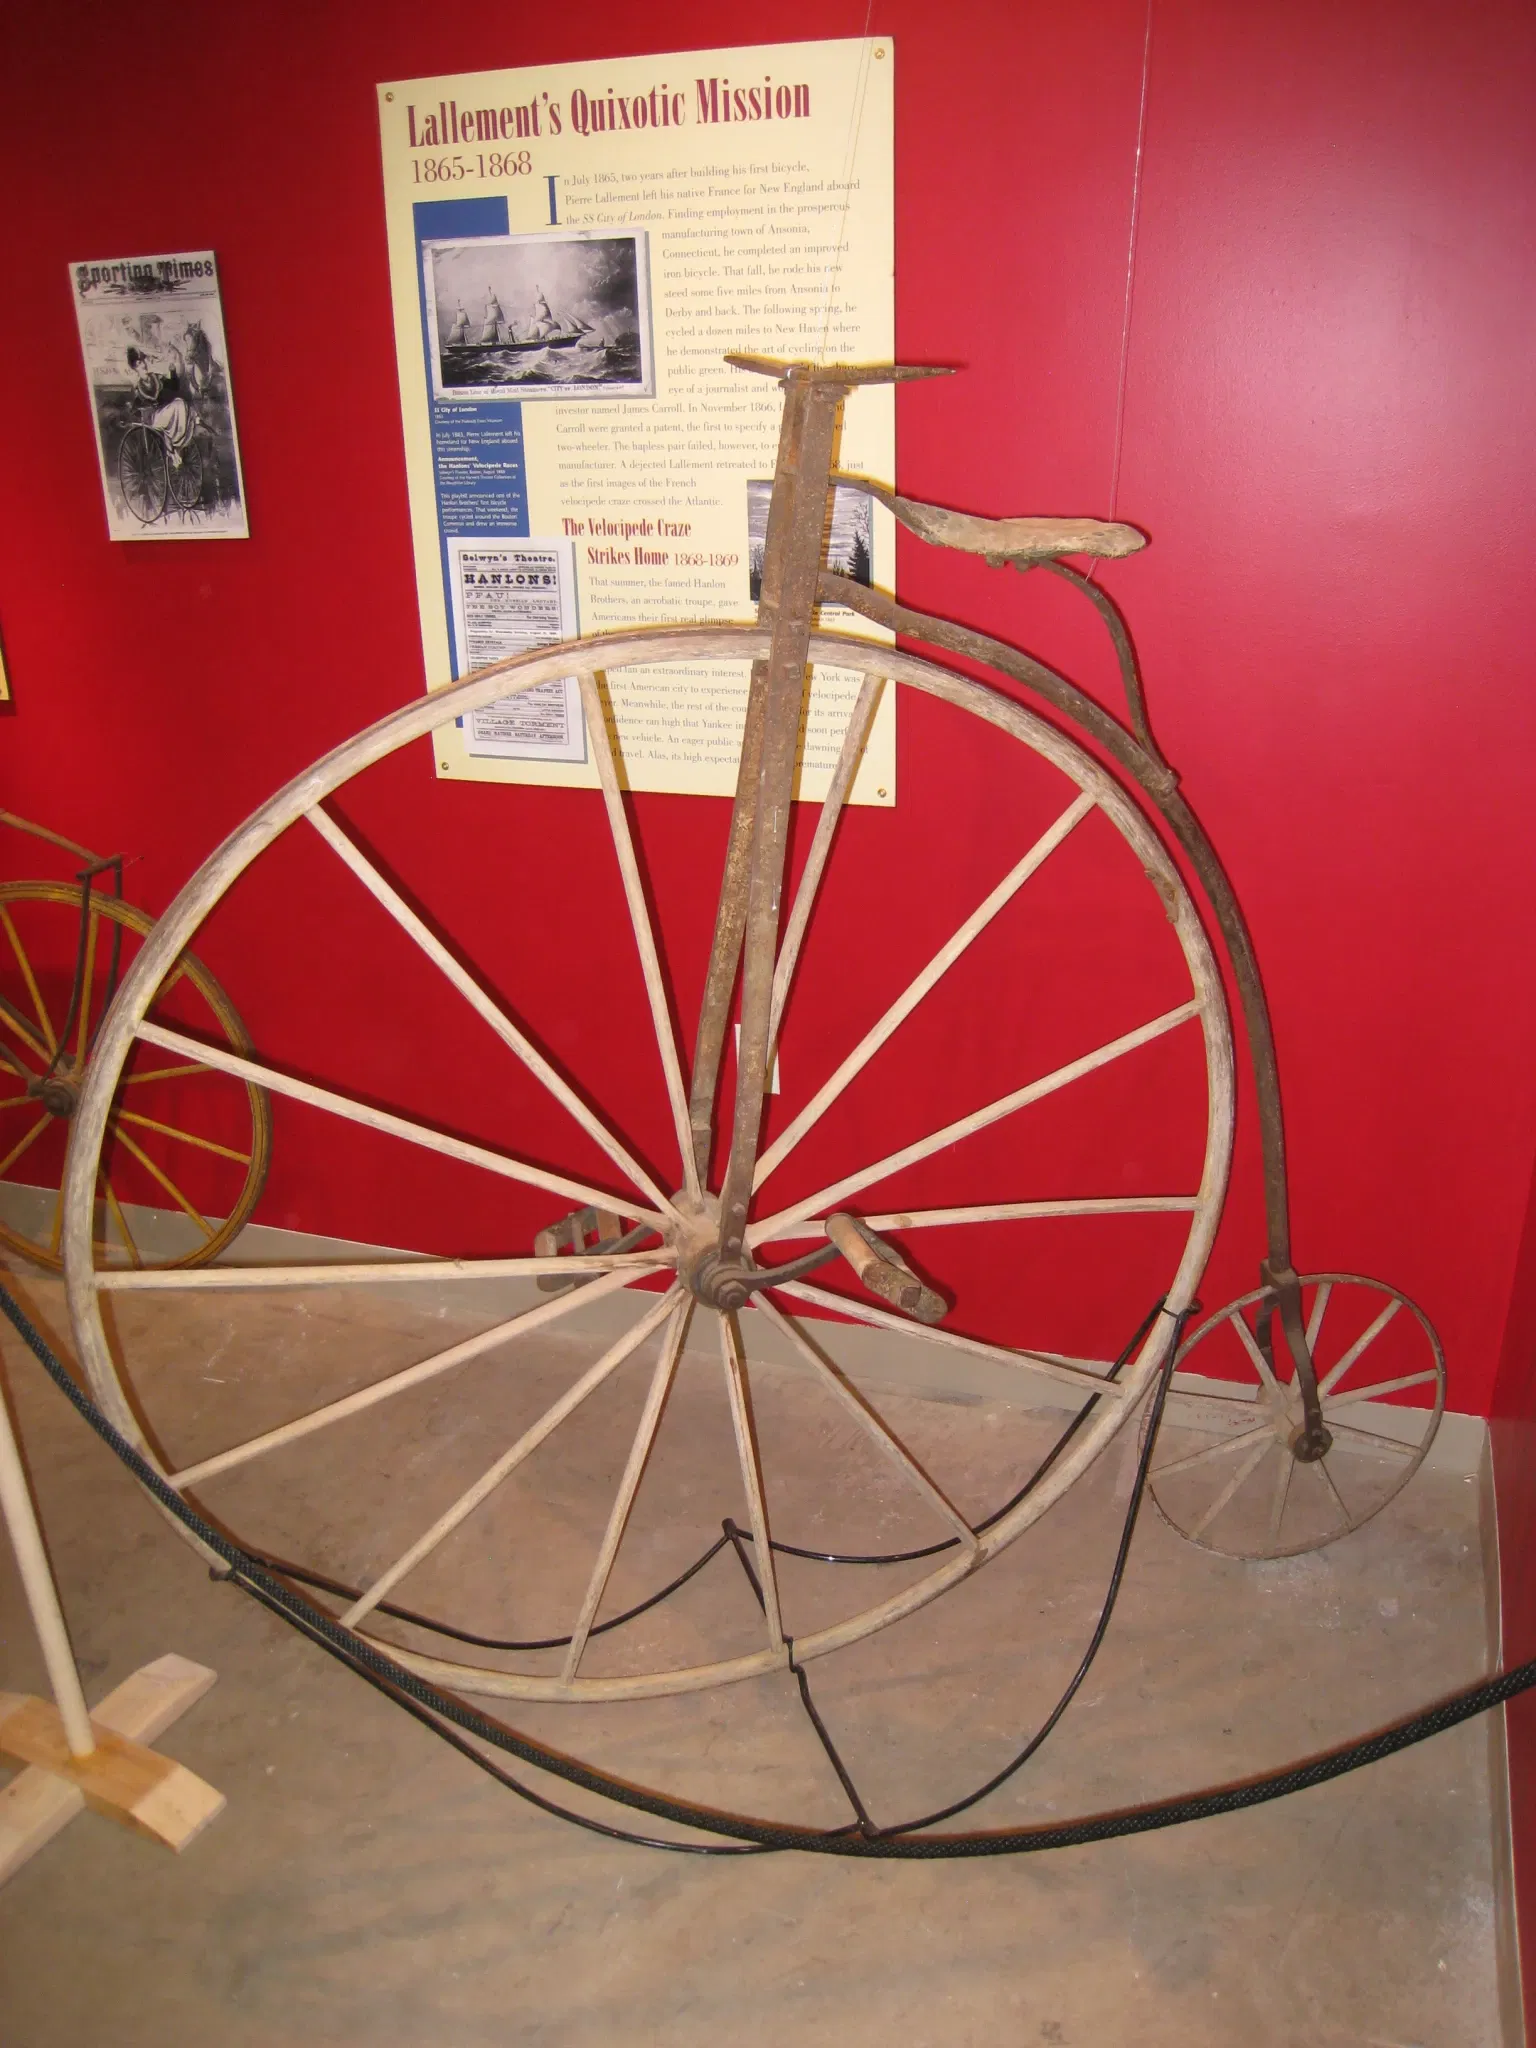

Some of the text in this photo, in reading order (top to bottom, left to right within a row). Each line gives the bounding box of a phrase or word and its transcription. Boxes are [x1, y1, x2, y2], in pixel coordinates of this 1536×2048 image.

[406, 76, 811, 147] Lallement's Quixotic Mission
[412, 151, 532, 183] 1865-1868
[572, 161, 810, 186] July 1865, two years after building his first bicycle,
[565, 179, 860, 205] Pierre Lallement left his native France for New England aboard
[567, 203, 796, 225] the City London. Finding employment the
[662, 224, 810, 240] manufacturing town Ansonia,
[662, 242, 849, 259] Connecticut, completed improved
[664, 263, 821, 281] iron bicycle. That fall, rode his
[664, 285, 786, 298] steed some five miles from
[665, 303, 806, 320] Derby and back. The following
[666, 324, 860, 339] cycled dozen miles New where
[680, 345, 743, 356] demonstrated
[744, 345, 759, 353] the
[788, 343, 823, 356] cycling
[840, 343, 855, 352] the
[668, 365, 695, 377] public
[699, 367, 726, 376] green.
[669, 386, 683, 394] eye
[705, 383, 748, 395] journalist
[752, 382, 768, 392] and
[556, 402, 775, 415] investor named James Carroll. November 1866,
[557, 424, 585, 433] Carroll
[611, 423, 643, 434] granted
[654, 424, 683, 433] patent,
[687, 422, 700, 431] the
[703, 423, 720, 431] first
[735, 421, 766, 433] specify
[558, 440, 757, 452] two-wheeler. The hapless pair failed, however,
[559, 459, 863, 471] manufacturer. dejected Lallement retreated just
[571, 478, 696, 489] the first images the French
[561, 497, 605, 507] velocipede
[633, 497, 666, 505] crossed
[668, 497, 682, 505] the
[685, 497, 723, 506] Atlantic.
[562, 518, 691, 540] The Velocipede Craze
[588, 546, 738, 567] Strikes Home 1868-1869
[464, 574, 556, 585] HANLONS!
[589, 576, 725, 588] That summer, the famed Hanlon
[590, 595, 738, 608] Brothers, acrobatic troupe, gave
[592, 612, 697, 623] Americans their first real
[653, 668, 708, 678] extraordinary
[820, 673, 840, 682] York
[630, 682, 748, 696] American city experience
[622, 699, 668, 709] Meanwhile,
[716, 702, 729, 711] the
[814, 708, 825, 716] its
[662, 717, 680, 728] high
[683, 718, 699, 727] that
[702, 719, 732, 729] Yankee
[682, 736, 733, 747] eager public
[648, 751, 668, 760] Alas,
[684, 753, 701, 763] high
